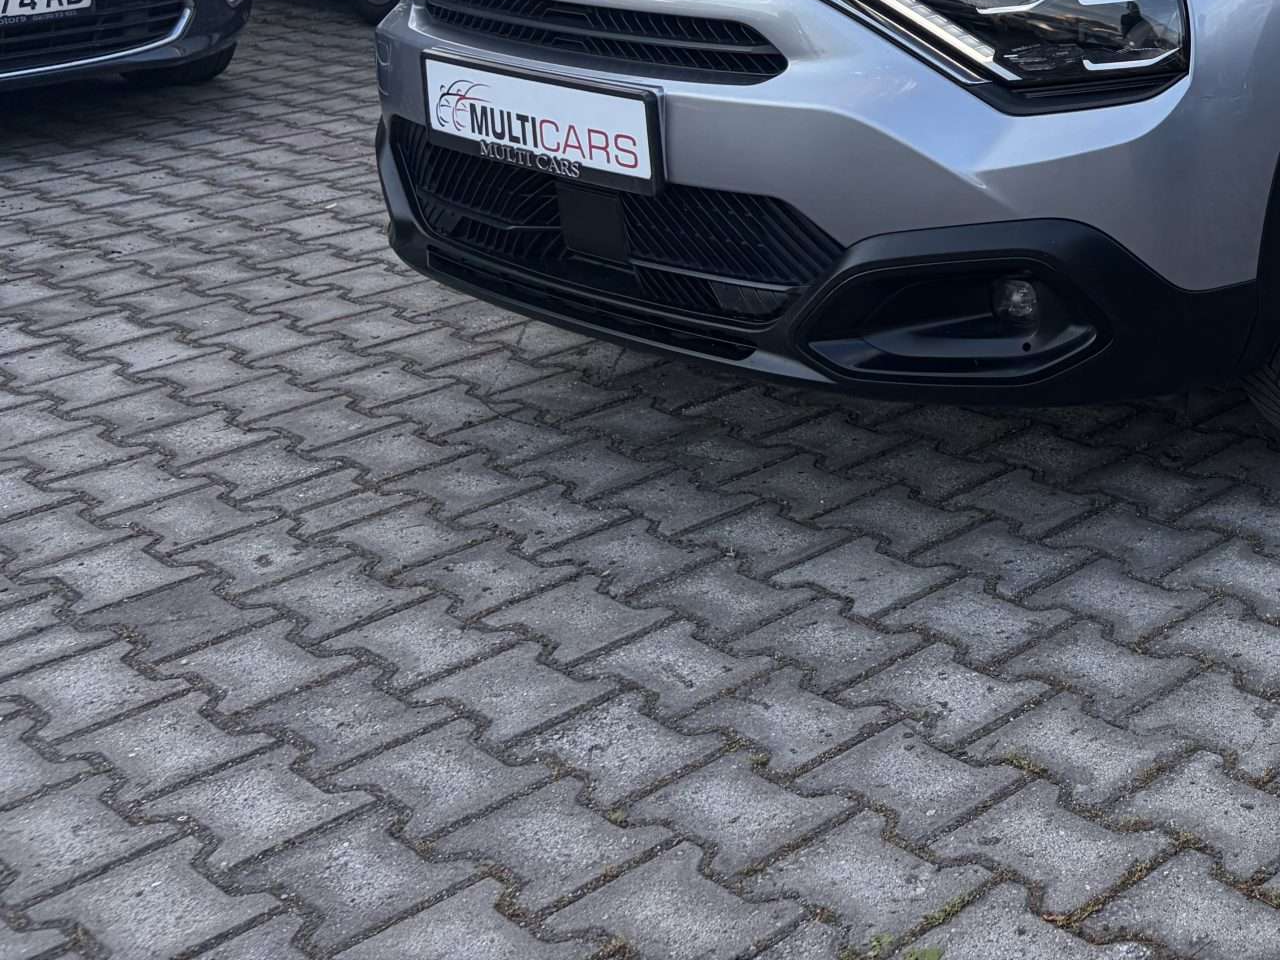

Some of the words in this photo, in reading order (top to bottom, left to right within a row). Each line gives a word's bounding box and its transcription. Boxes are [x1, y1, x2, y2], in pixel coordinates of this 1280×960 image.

[469, 102, 640, 169] MULTICARS
[479, 139, 534, 167] MULTI
[535, 153, 583, 178] CARS
